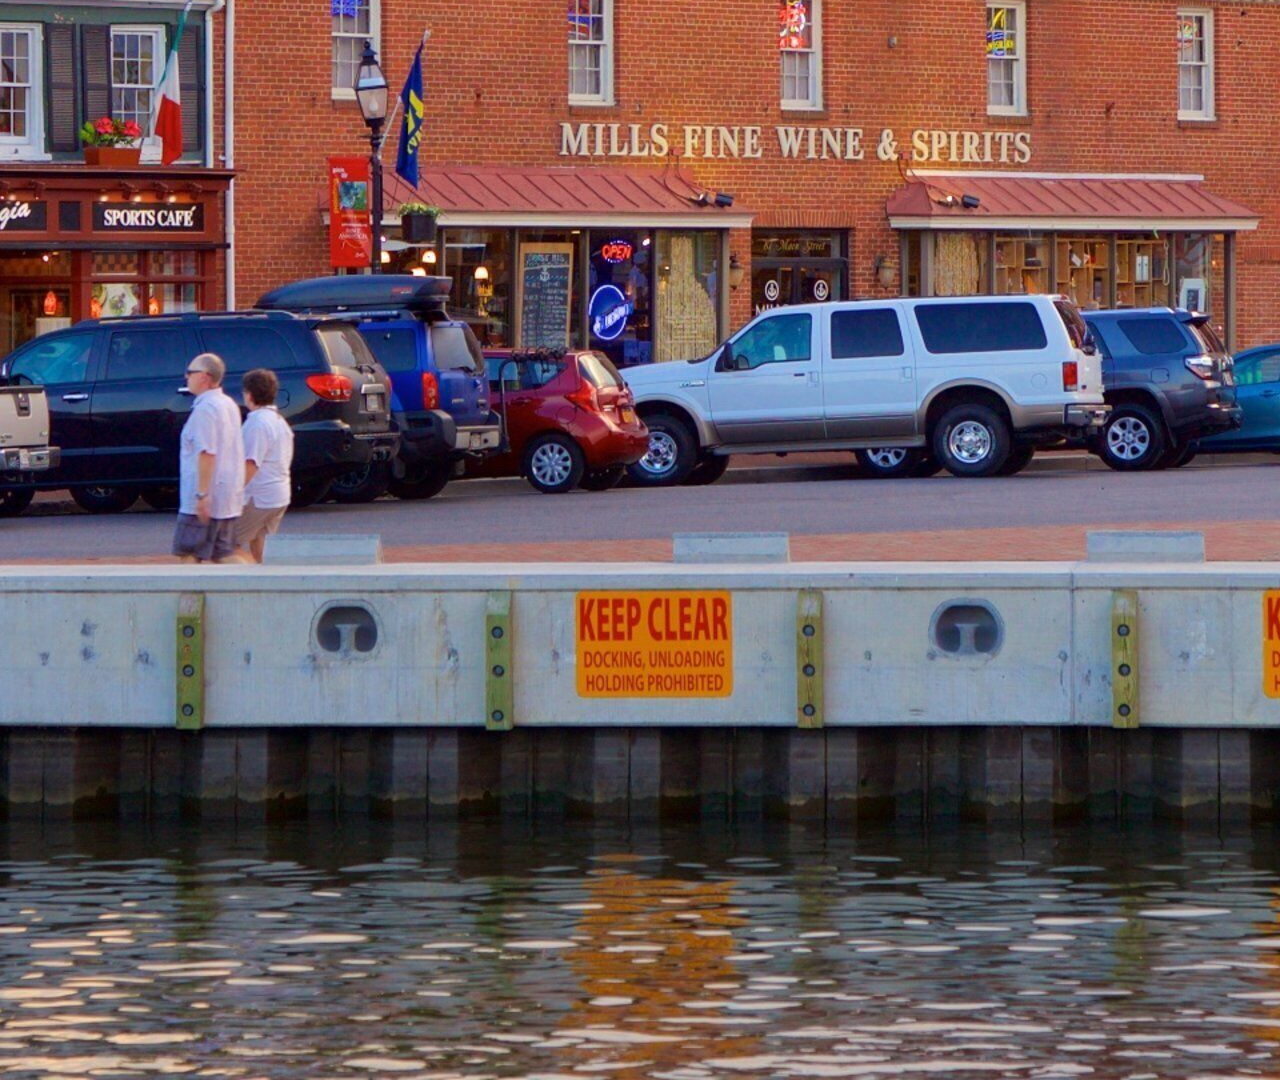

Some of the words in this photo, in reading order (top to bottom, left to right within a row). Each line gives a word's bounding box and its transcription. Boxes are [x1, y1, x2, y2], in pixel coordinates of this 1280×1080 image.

[559, 122, 669, 157] MILLS
[682, 125, 764, 159] FINE
[775, 126, 865, 160] WINE
[876, 128, 899, 161] &
[911, 130, 1032, 164] SPIRITS
[103, 209, 156, 227] SPORTS
[602, 245, 633, 259] OPEN
[579, 597, 642, 642] KEEP
[647, 597, 729, 642] CLEAR
[583, 651, 646, 670] DOCKING,
[648, 650, 725, 668] UNLOADING
[586, 674, 644, 692] HOLDING
[647, 674, 724, 692] PROHIBITED
